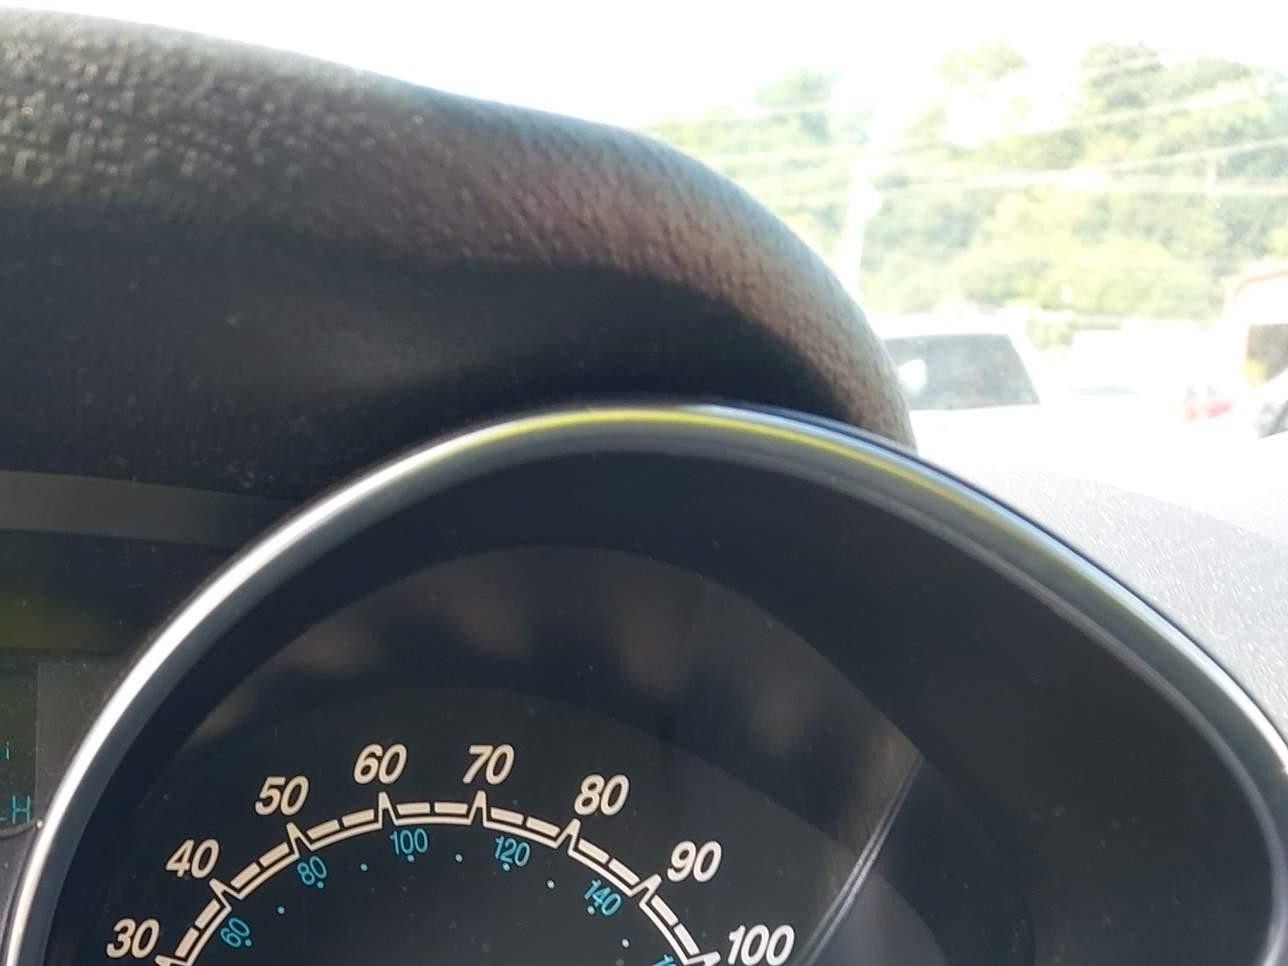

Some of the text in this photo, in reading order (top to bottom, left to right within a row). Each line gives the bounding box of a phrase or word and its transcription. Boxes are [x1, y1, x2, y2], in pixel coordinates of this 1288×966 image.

[353, 744, 407, 783] 60
[462, 745, 514, 784] 70
[254, 776, 308, 815] 50
[575, 775, 629, 814] 80
[166, 839, 220, 878] 40
[390, 828, 428, 854] 100
[494, 836, 531, 867] 120
[297, 857, 327, 886] 80
[669, 841, 722, 881] 90
[584, 880, 621, 917] 140
[106, 919, 160, 959] 30
[220, 919, 251, 948] 60
[728, 926, 795, 965] 100
